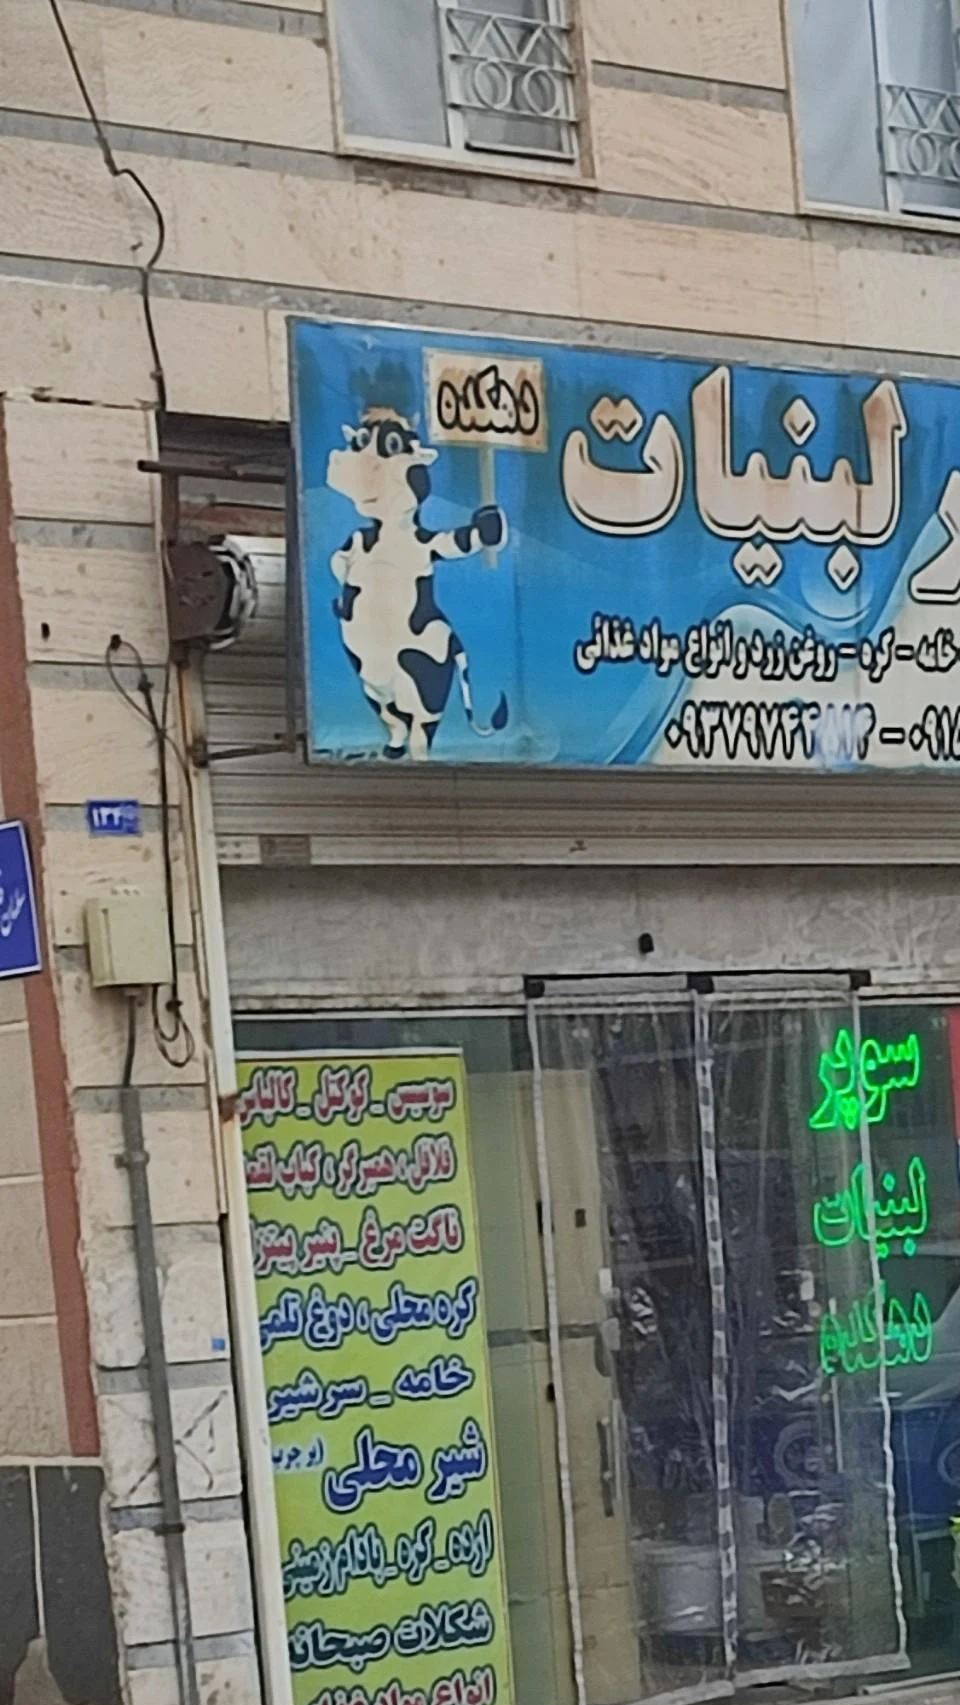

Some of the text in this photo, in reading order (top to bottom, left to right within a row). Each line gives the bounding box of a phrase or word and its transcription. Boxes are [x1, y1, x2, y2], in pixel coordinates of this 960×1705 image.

[437, 364, 539, 436] دهکده
[561, 365, 907, 592] لبنیات
[638, 614, 682, 678] مواد
[683, 617, 735, 681] انواع
[731, 635, 751, 680] و
[749, 628, 786, 682] زرد
[788, 622, 840, 683] روغن
[858, 626, 896, 684] کره
[915, 627, 958, 673] خامه
[808, 1028, 920, 1130] سوپر
[244, 1141, 279, 1192] لقم
[277, 1140, 323, 1200] کباب
[407, 1133, 456, 1194] فلافل
[358, 1205, 404, 1271] مرغ
[813, 1156, 929, 1258] لبنیات
[250, 1213, 299, 1278] پیتز
[300, 1216, 343, 1276] پنیر
[303, 1283, 354, 1351] دوغ
[369, 1280, 433, 1345] محلی
[434, 1276, 478, 1340] کره
[393, 1354, 475, 1400] خامه
[321, 1424, 424, 1514] محلی
[425, 1417, 488, 1503] شیر
[396, 1516, 436, 1586] کره
[446, 1508, 495, 1577] ارده
[393, 1598, 495, 1658] شکلات
